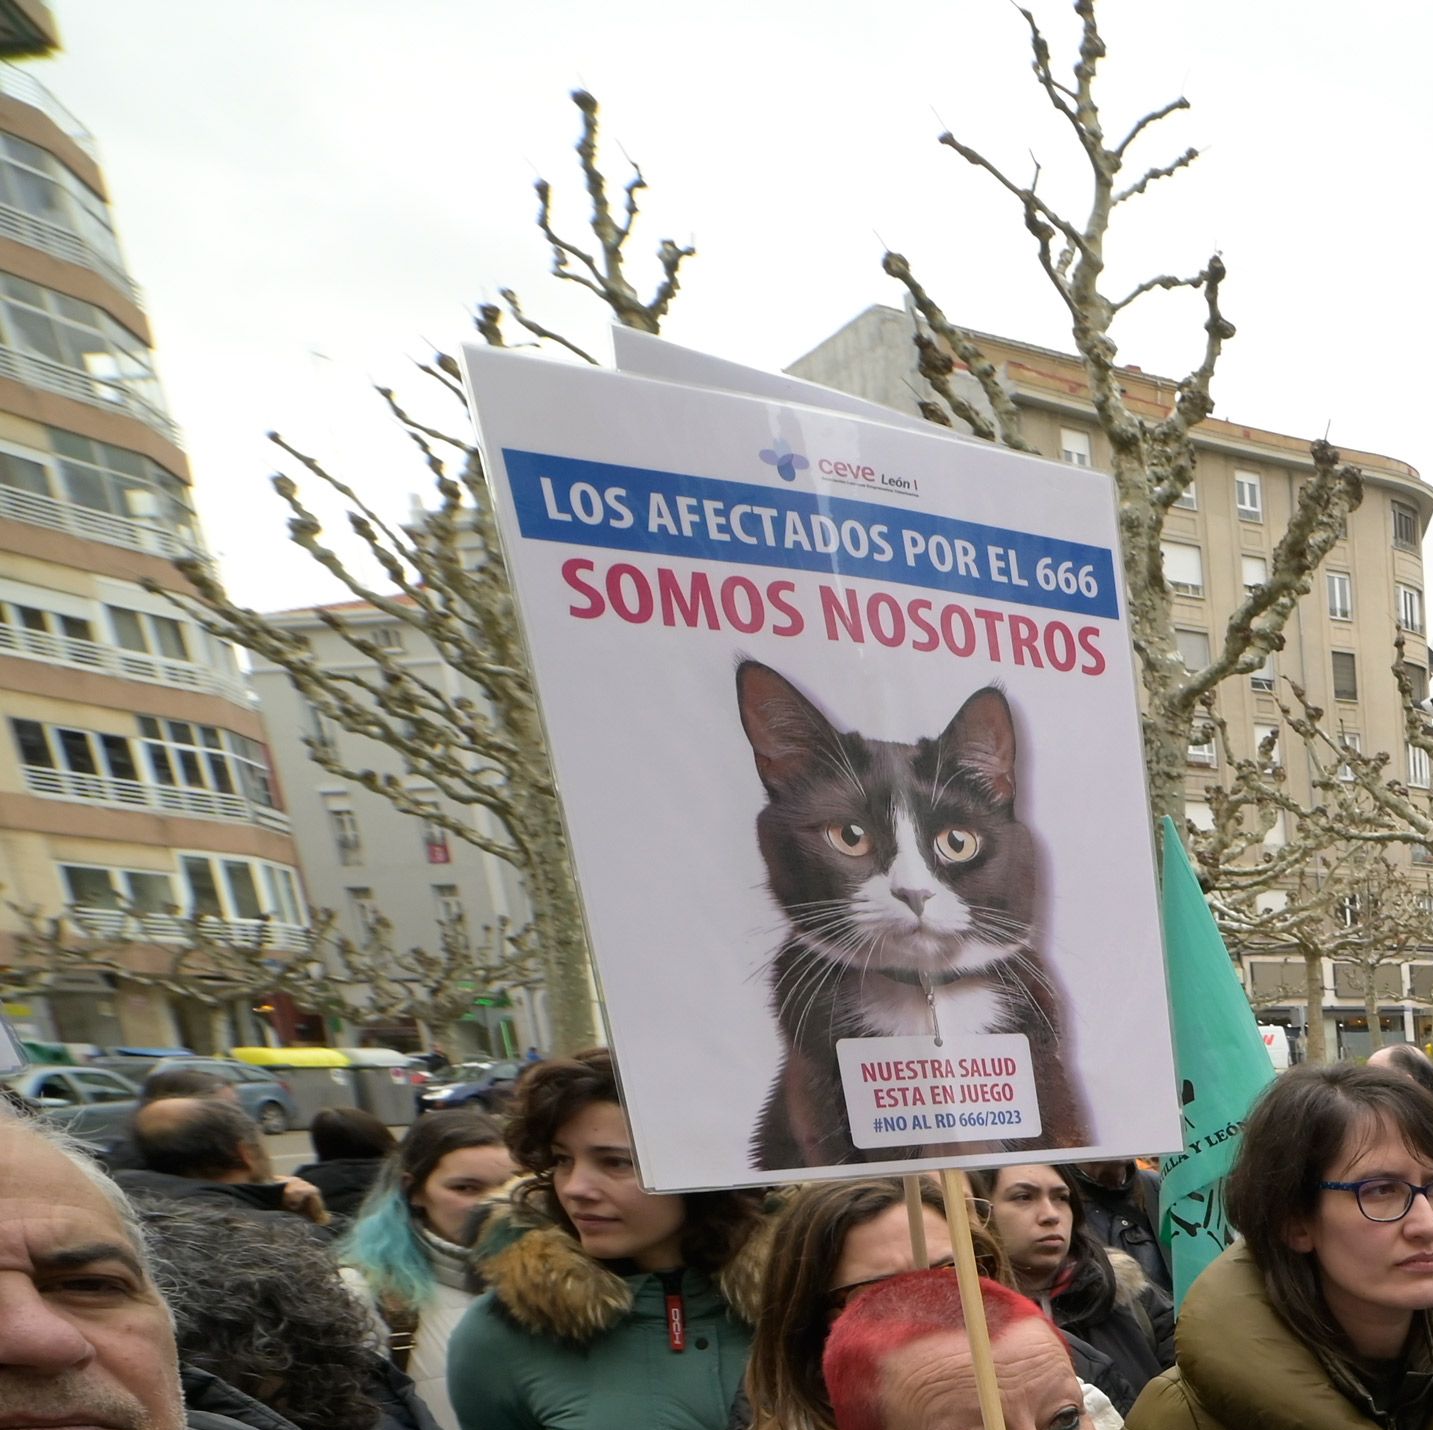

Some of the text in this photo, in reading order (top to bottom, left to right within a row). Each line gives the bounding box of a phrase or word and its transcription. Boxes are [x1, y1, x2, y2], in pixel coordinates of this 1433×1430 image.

[818, 457, 875, 483] ceve
[881, 473, 911, 490] León
[540, 476, 1099, 599] LOS AFECTADOS POR EL 666
[561, 558, 1106, 677] SOMOS NOSOTROS
[860, 1057, 1016, 1082] NUESTRA SALUD
[873, 1083, 1014, 1109] ESTA EN JUEGO
[873, 1110, 1022, 1133] #NO AL RD 666/2023
[1189, 1140, 1202, 1154] Y
